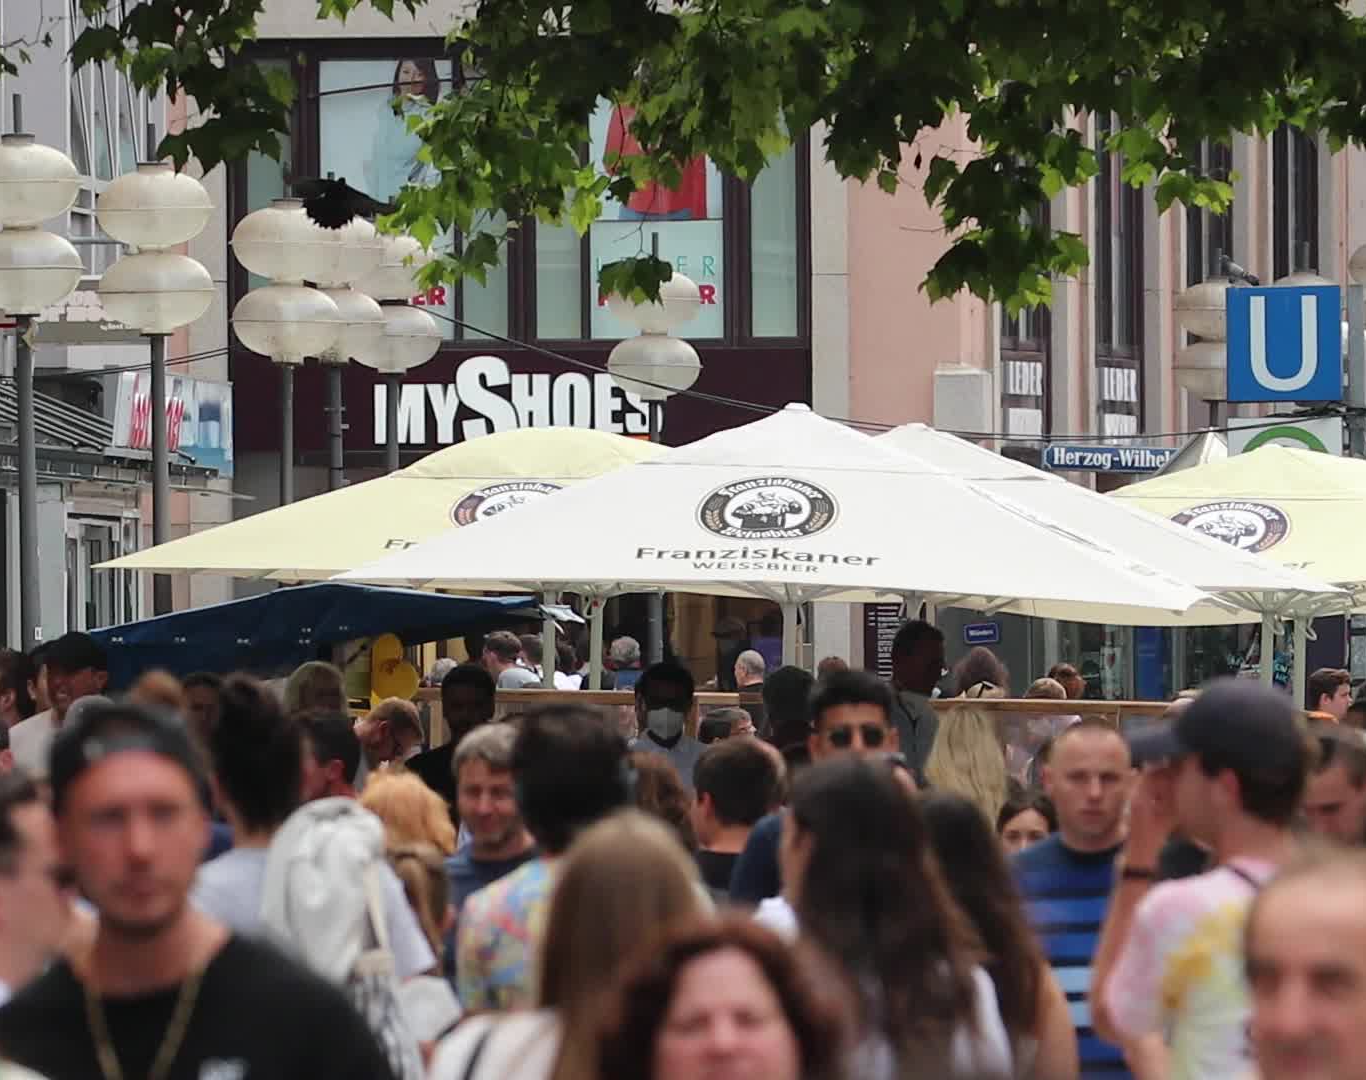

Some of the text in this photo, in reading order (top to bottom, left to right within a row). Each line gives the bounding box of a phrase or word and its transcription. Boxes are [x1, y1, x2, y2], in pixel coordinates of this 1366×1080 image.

[1249, 295, 1317, 392] U
[1009, 361, 1043, 396] LEDER
[1103, 367, 1137, 402] LEDER
[1053, 446, 1171, 471] Herzog-Wilhel
[635, 546, 881, 567] Franziskaner
[692, 561, 819, 573] WEISSBIER
